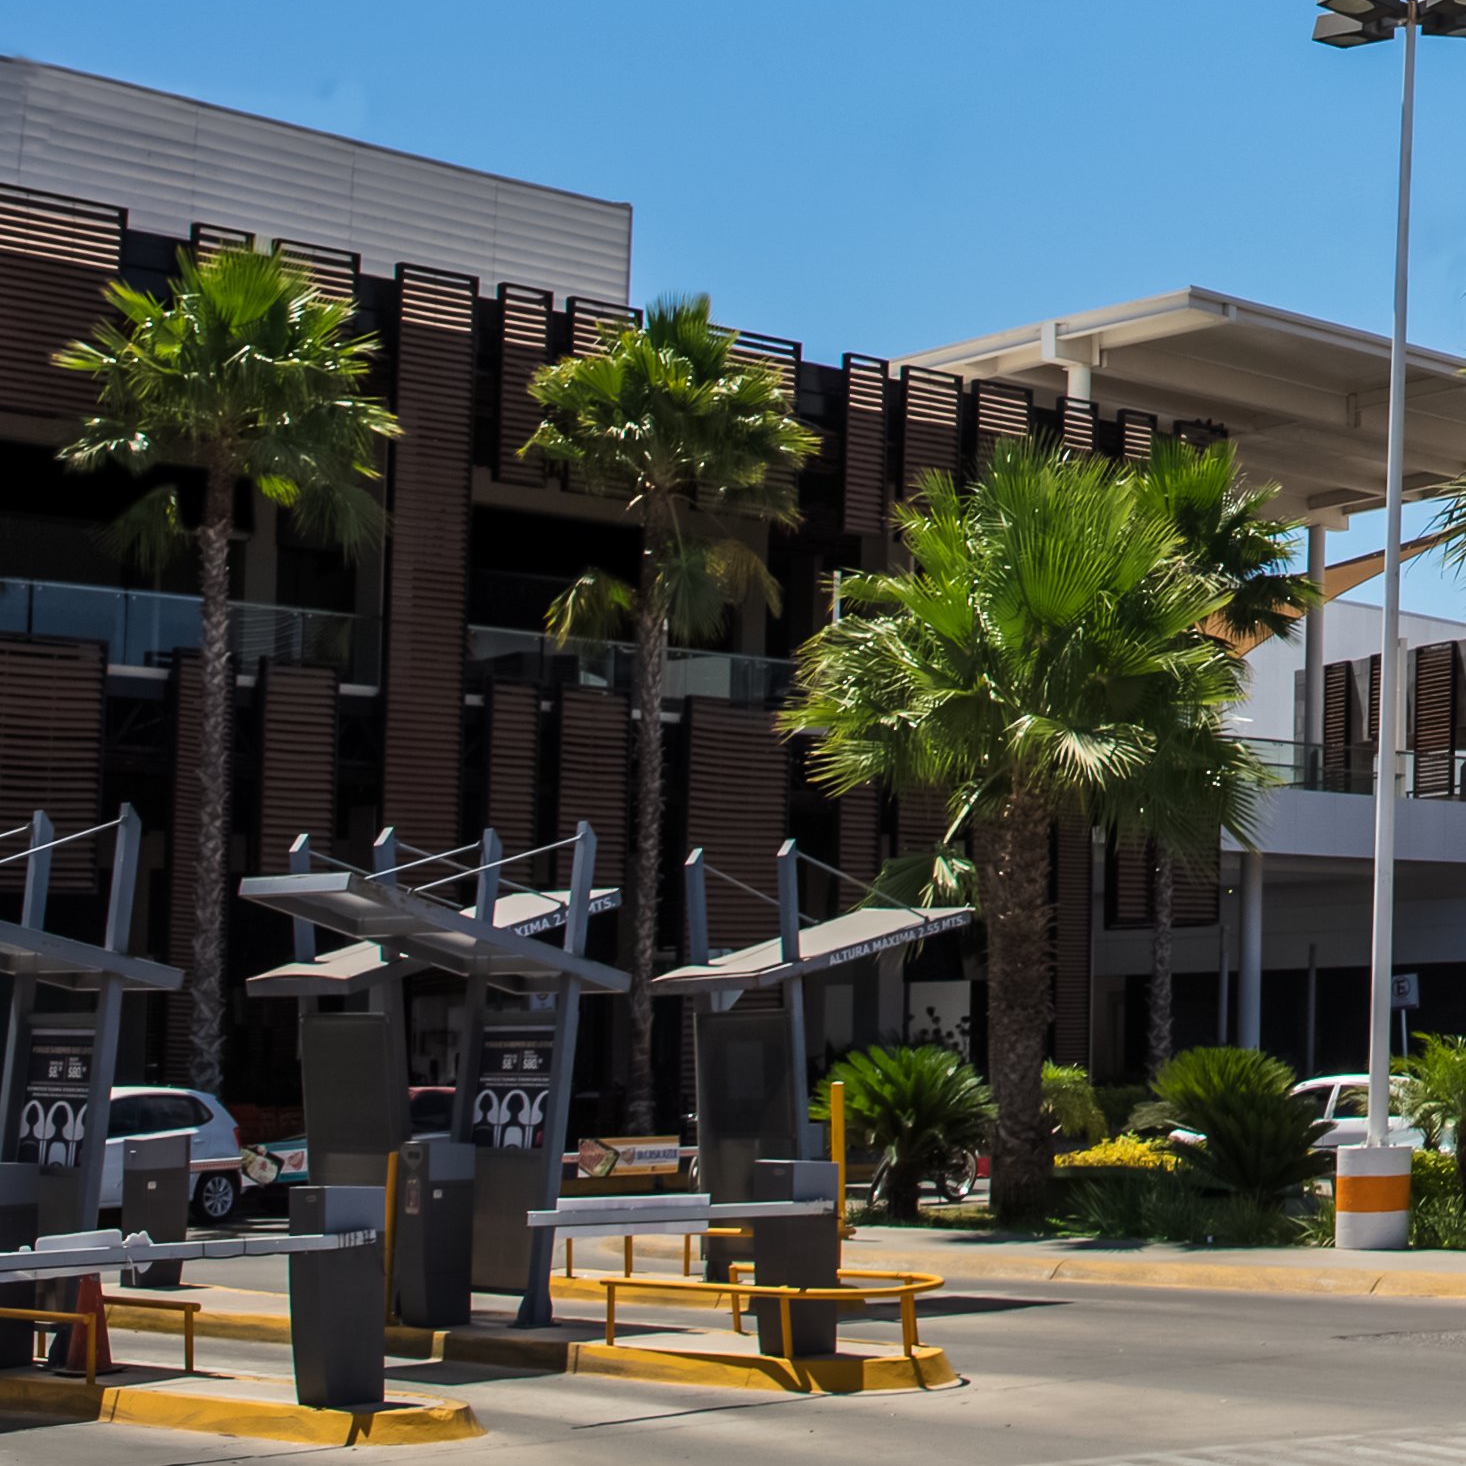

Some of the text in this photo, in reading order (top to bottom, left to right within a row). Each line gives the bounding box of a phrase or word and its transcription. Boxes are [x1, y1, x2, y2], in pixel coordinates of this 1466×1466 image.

[514, 916, 550, 937] XIMA
[829, 944, 870, 966] ALTURA
[918, 922, 940, 939] 2.55
